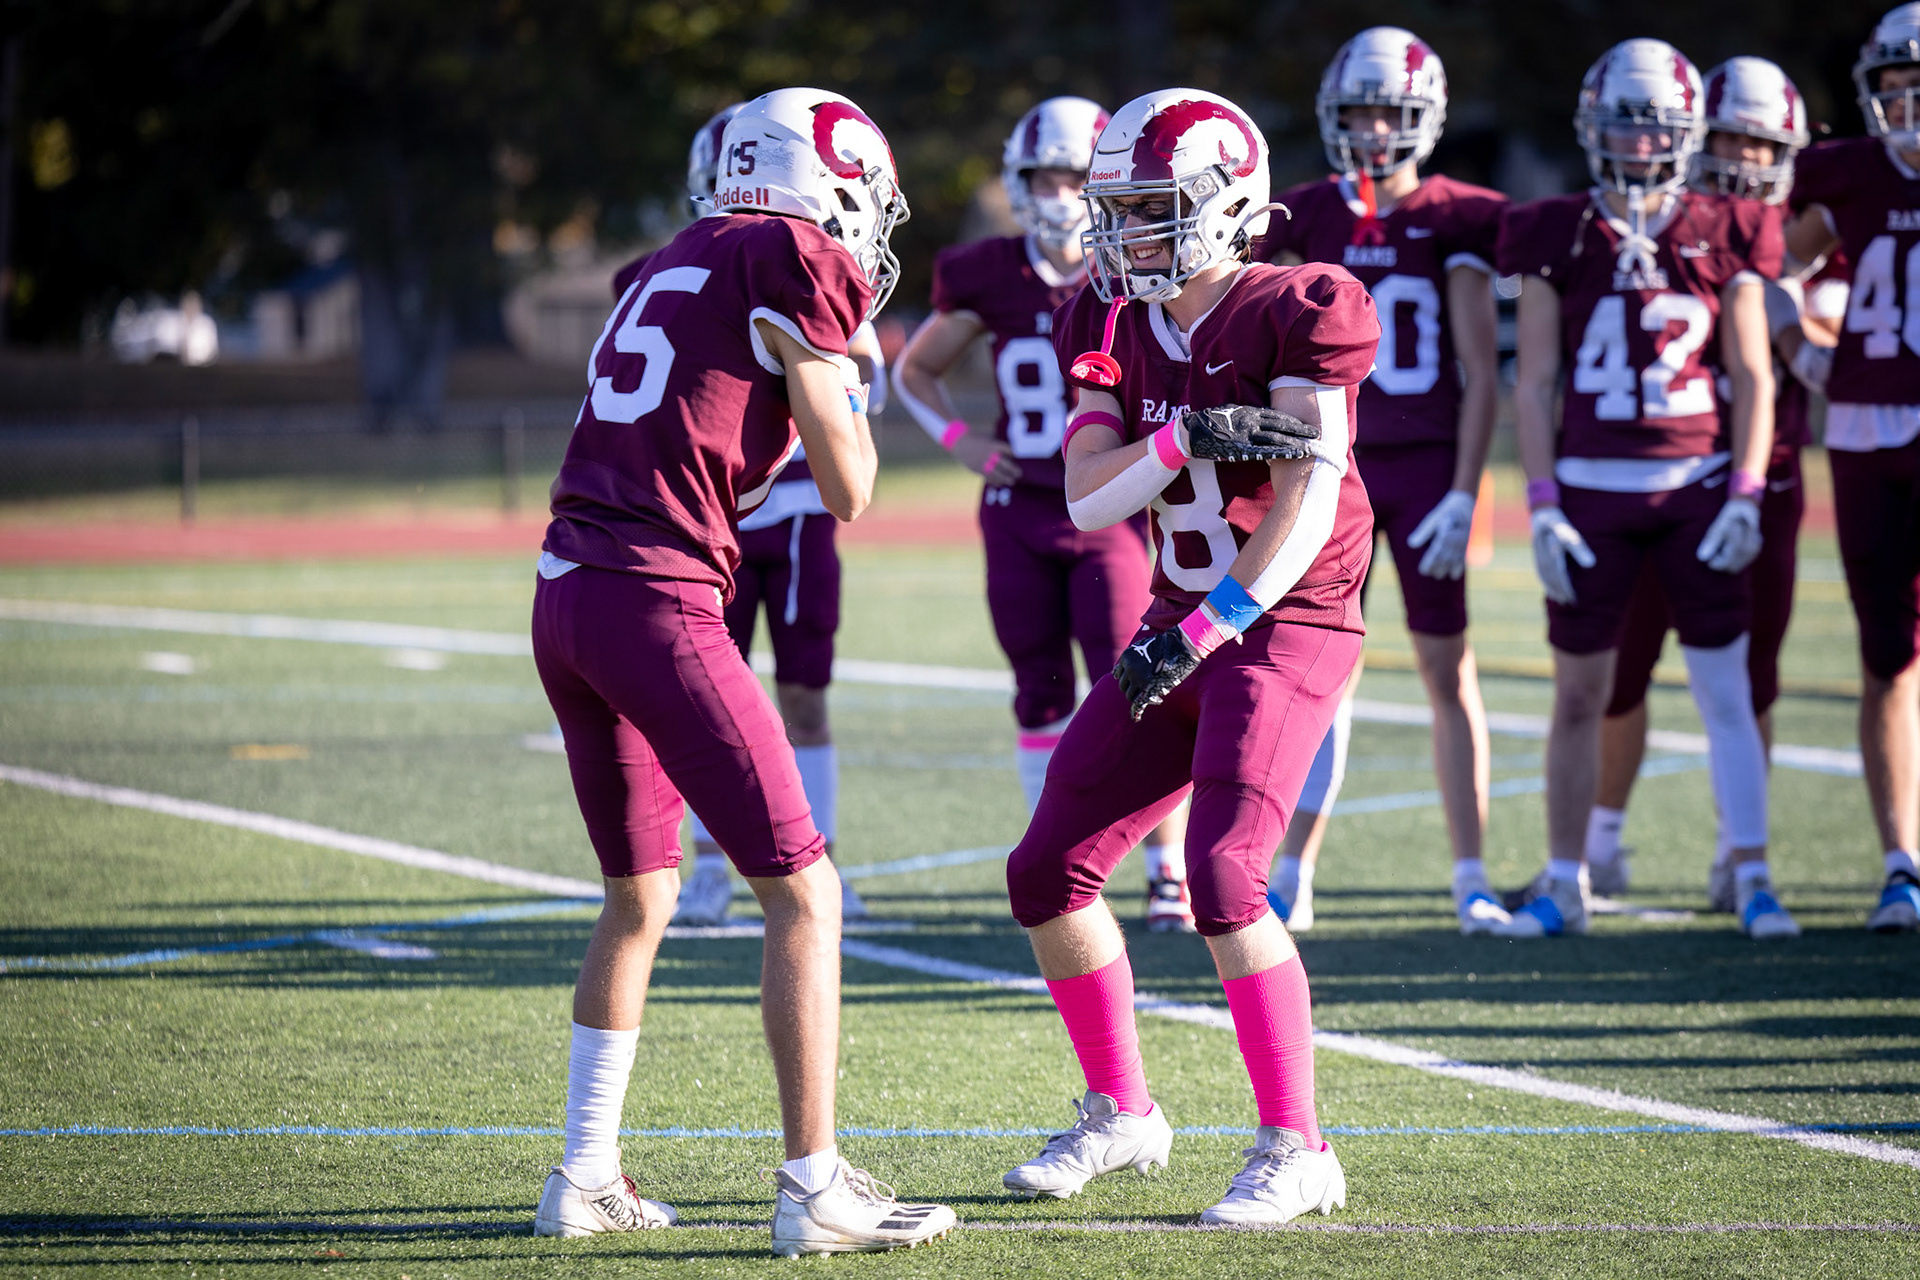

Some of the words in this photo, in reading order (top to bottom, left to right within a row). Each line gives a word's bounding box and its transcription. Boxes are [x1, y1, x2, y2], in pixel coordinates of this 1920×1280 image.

[727, 140, 758, 177] 15
[1091, 169, 1121, 181] Riddell
[713, 186, 770, 211] Riddell
[1574, 292, 1715, 421] 42
[1150, 457, 1240, 592] 8
